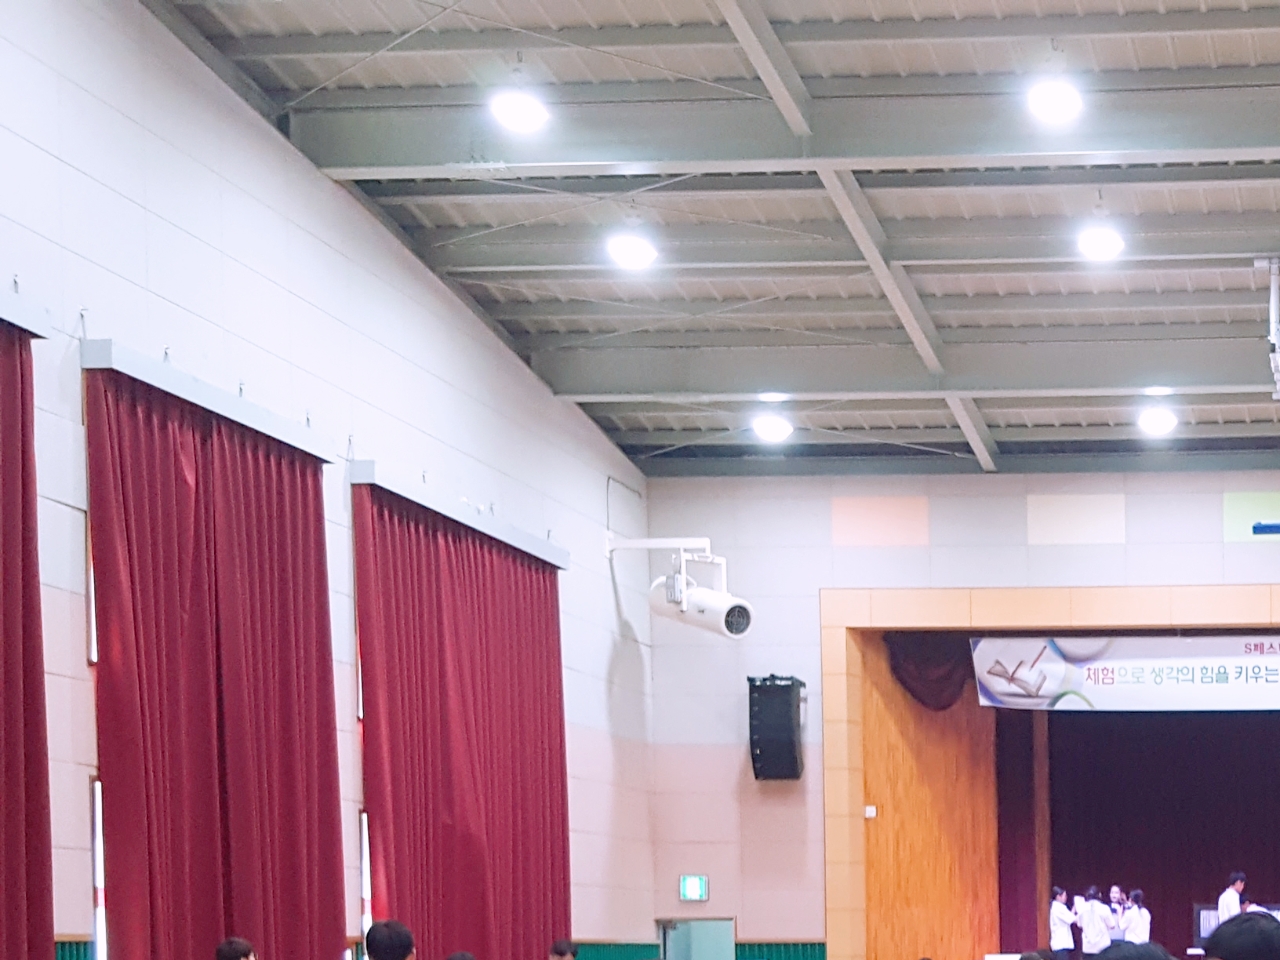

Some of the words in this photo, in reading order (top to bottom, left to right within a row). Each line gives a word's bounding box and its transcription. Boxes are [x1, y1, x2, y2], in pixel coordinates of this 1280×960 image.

[1085, 666, 1146, 686] 체험으로
[1150, 665, 1195, 686] 생각의
[1200, 665, 1229, 684] 힘을
[1234, 664, 1280, 684] 키우는
